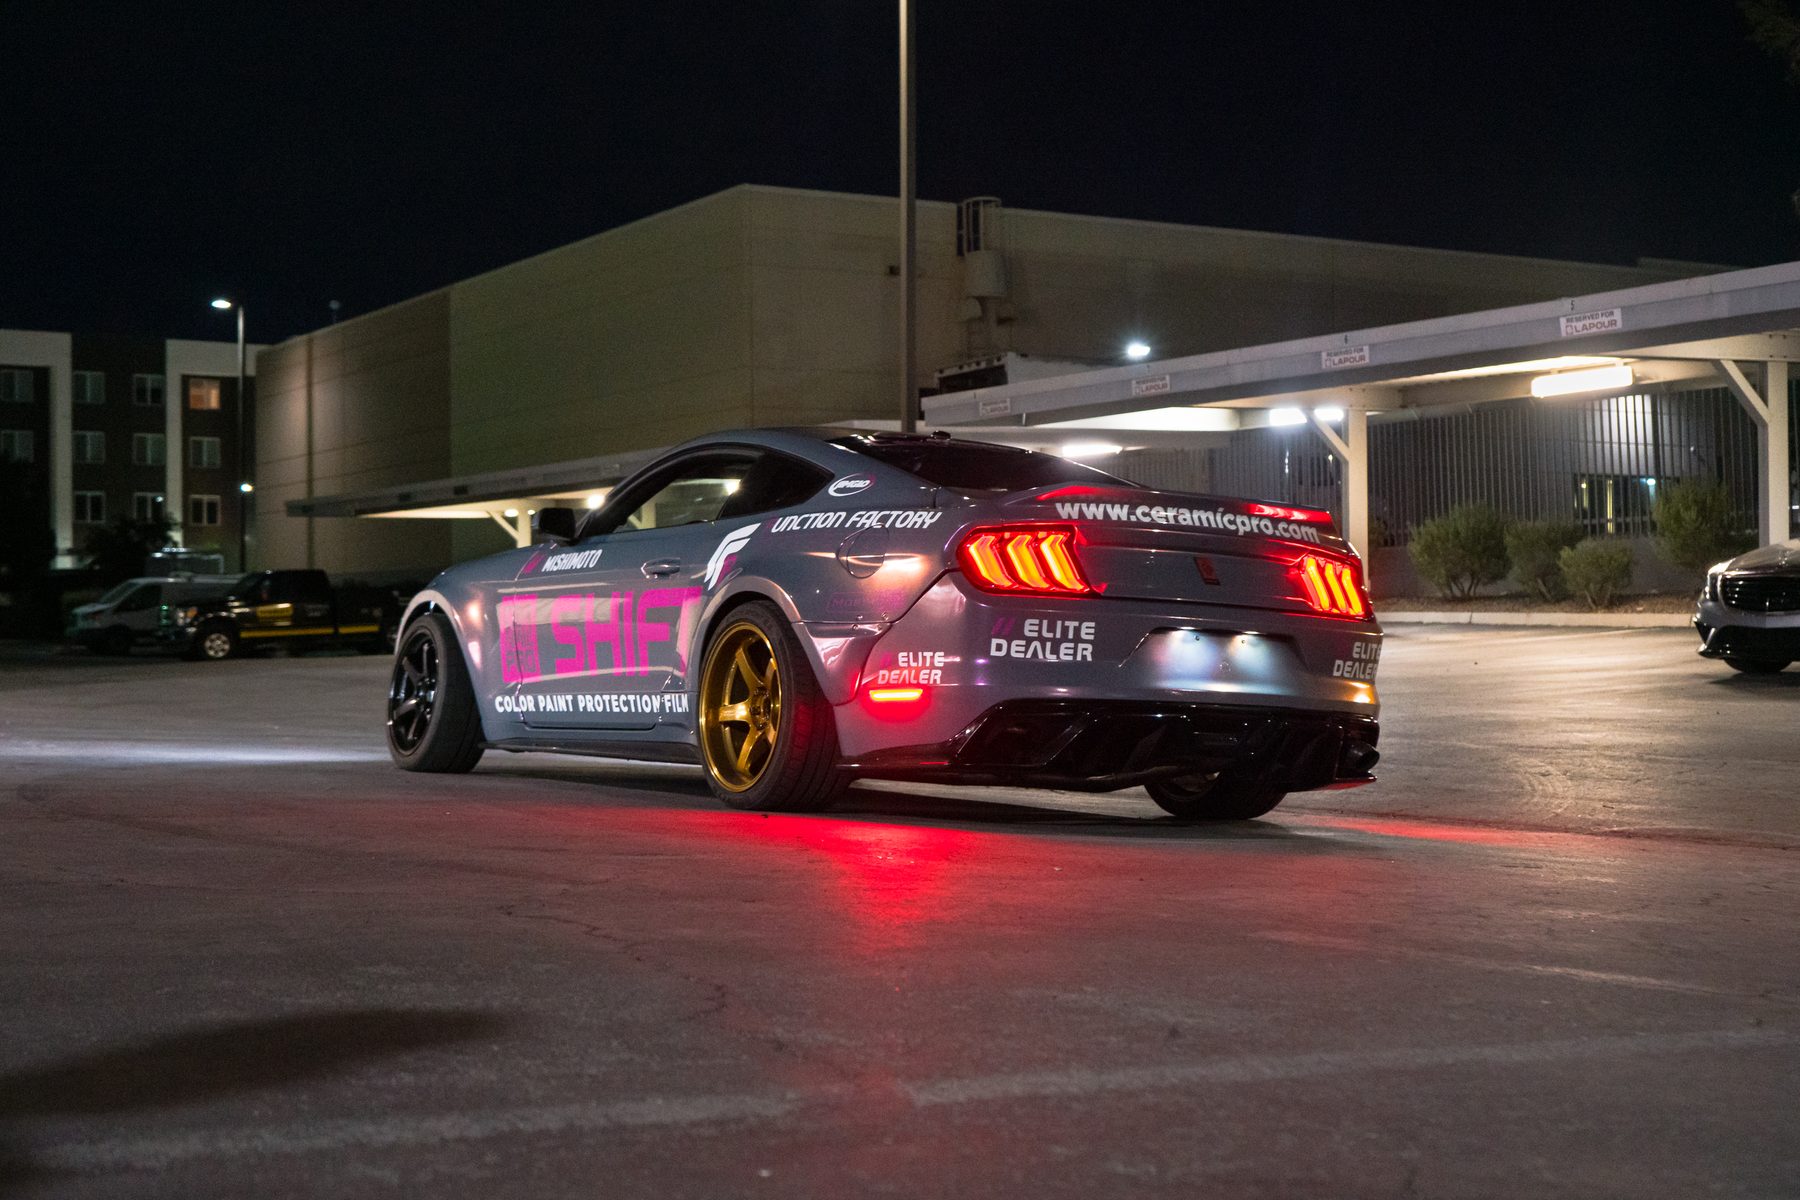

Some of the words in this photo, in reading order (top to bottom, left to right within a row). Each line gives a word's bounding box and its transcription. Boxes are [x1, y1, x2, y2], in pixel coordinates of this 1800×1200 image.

[1601, 310, 1615, 318] FOR
[845, 511, 943, 529] FACTORY
[1055, 502, 1320, 544] www.ceramicpro.com
[541, 549, 603, 572] MISHIMOTO
[1023, 618, 1096, 640] ELITE
[898, 651, 945, 667] ELITE
[990, 638, 1093, 662] DEALER
[877, 669, 942, 685] DEALER
[495, 695, 536, 713] COLOR
[538, 694, 573, 712] PAINT
[578, 694, 660, 713] PROTECTION
[663, 693, 689, 712] FILM
